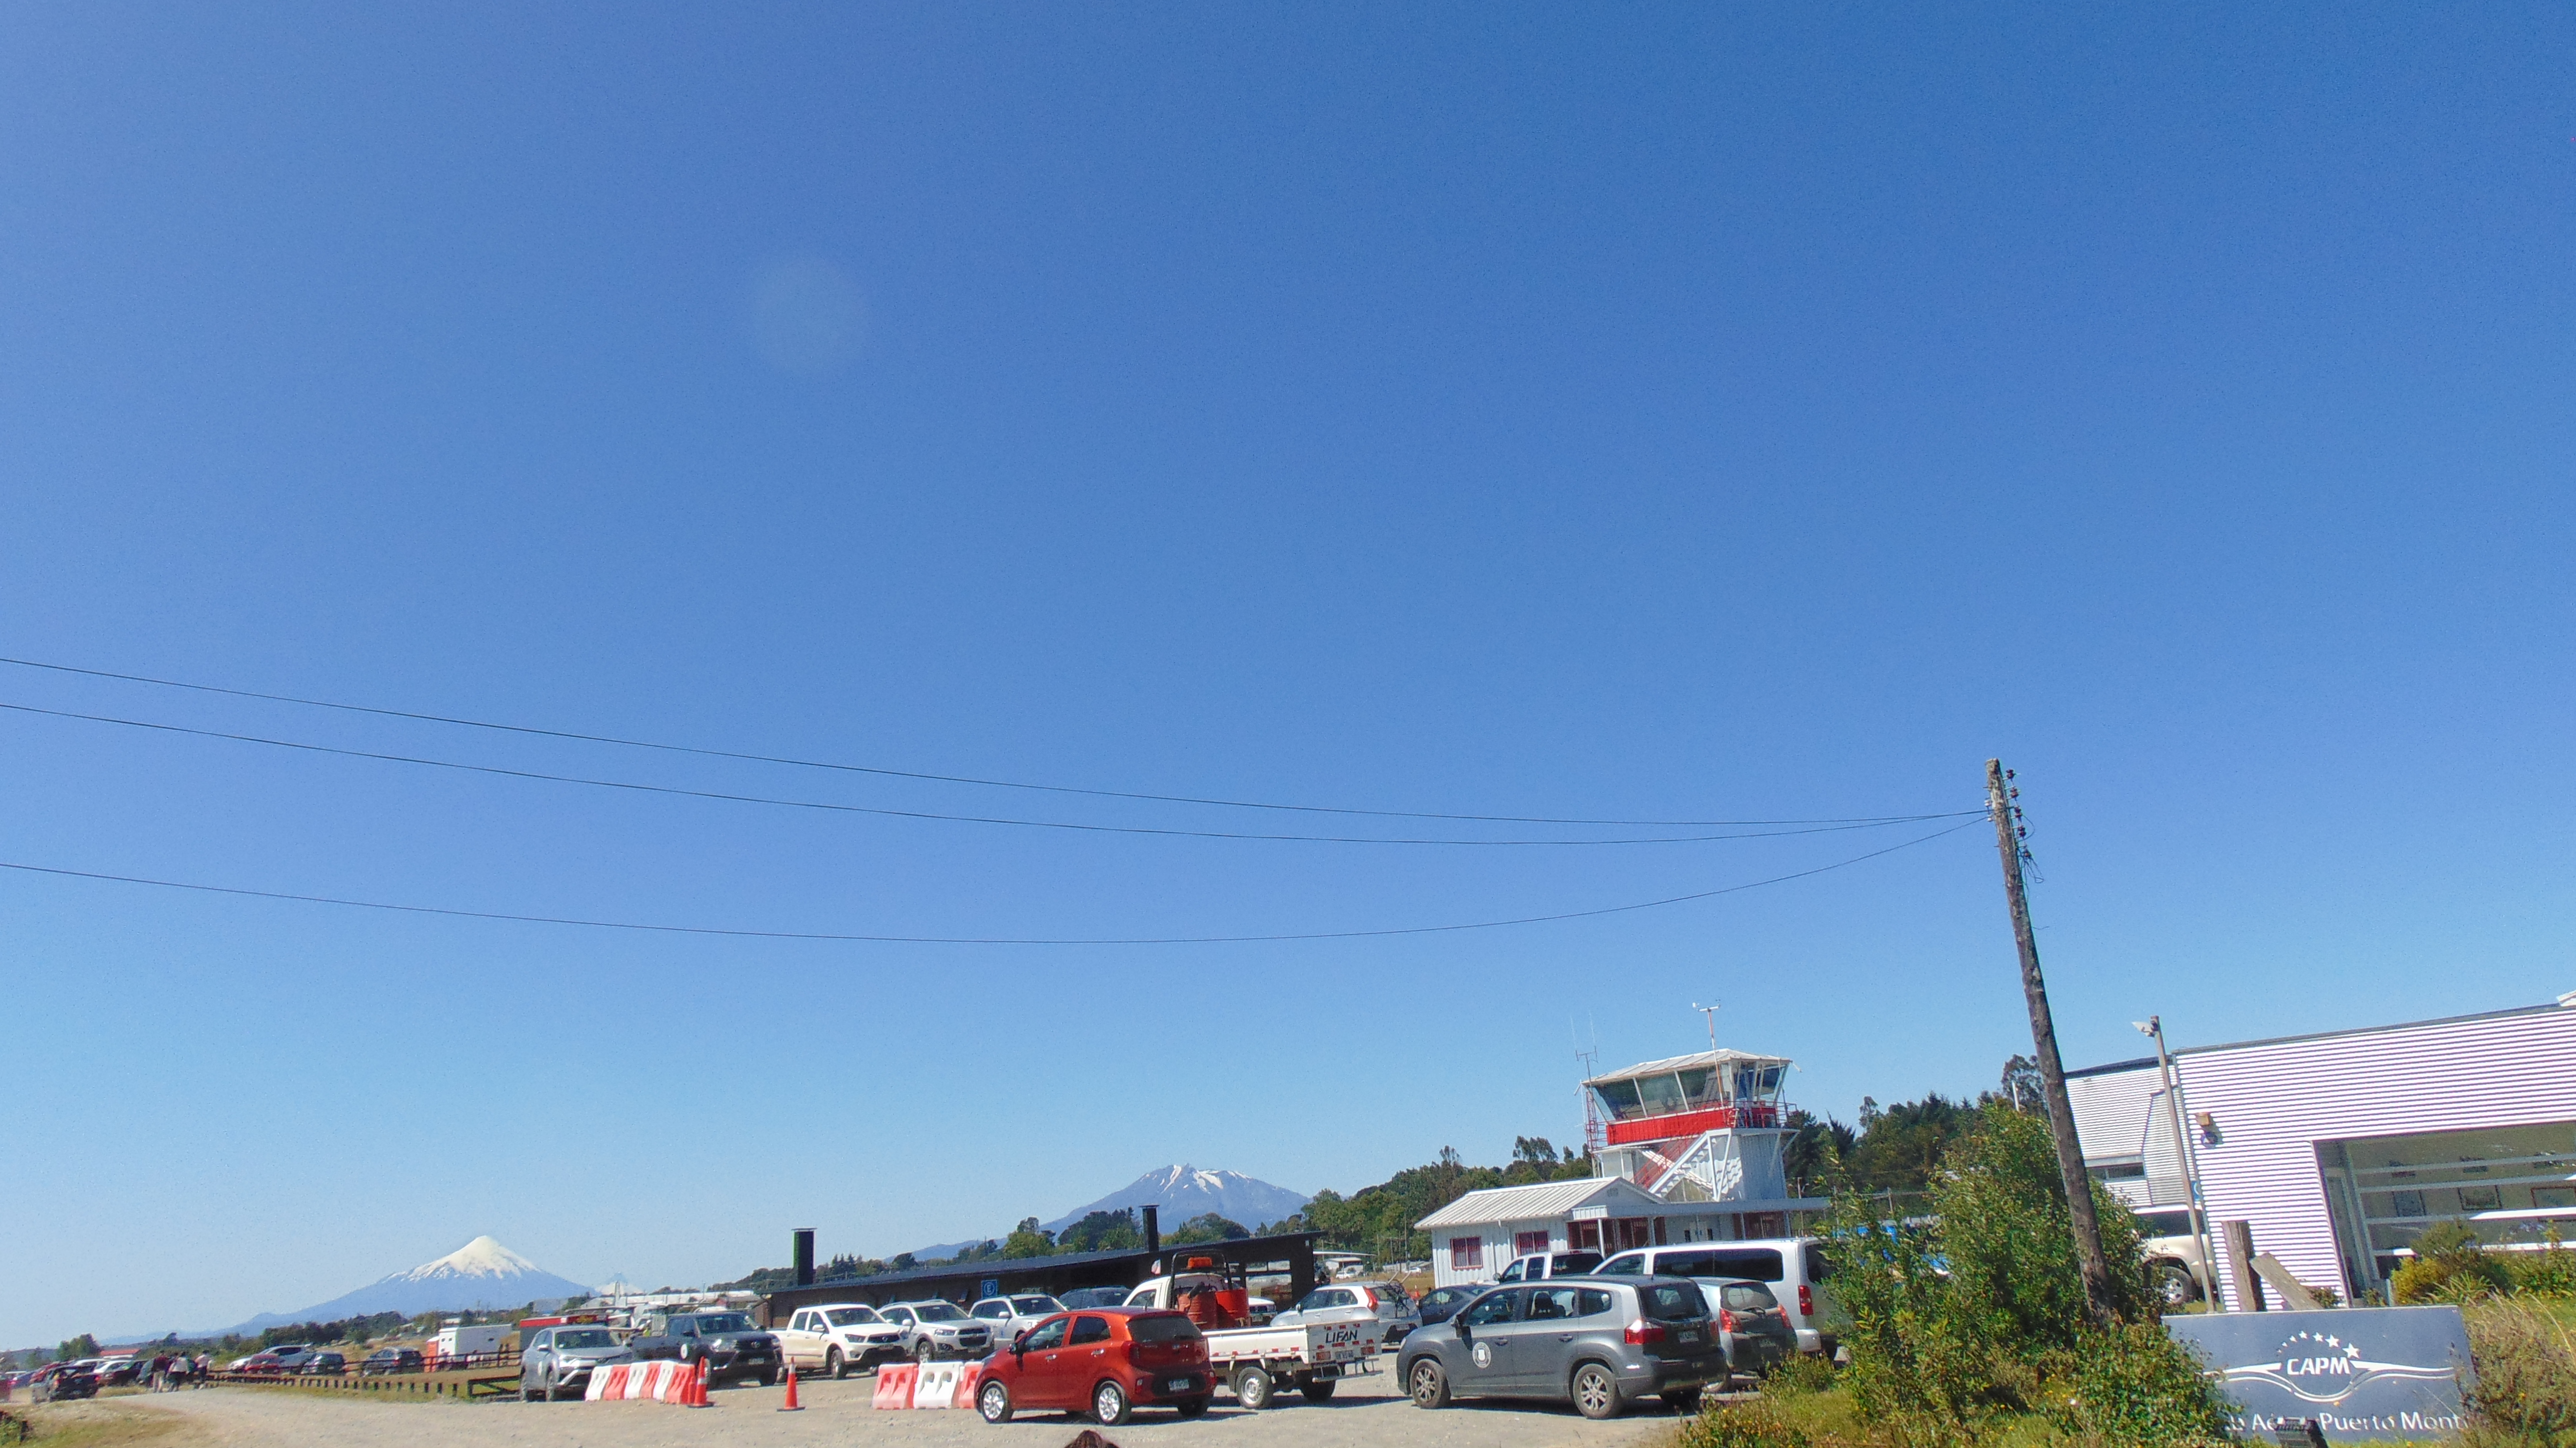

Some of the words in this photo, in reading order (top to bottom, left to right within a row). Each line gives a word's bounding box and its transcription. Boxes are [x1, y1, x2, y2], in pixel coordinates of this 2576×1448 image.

[1326, 1330, 1358, 1344] LIFAN
[2286, 1357, 2350, 1375] CAPM
[2319, 1412, 2395, 1430] Puerto
